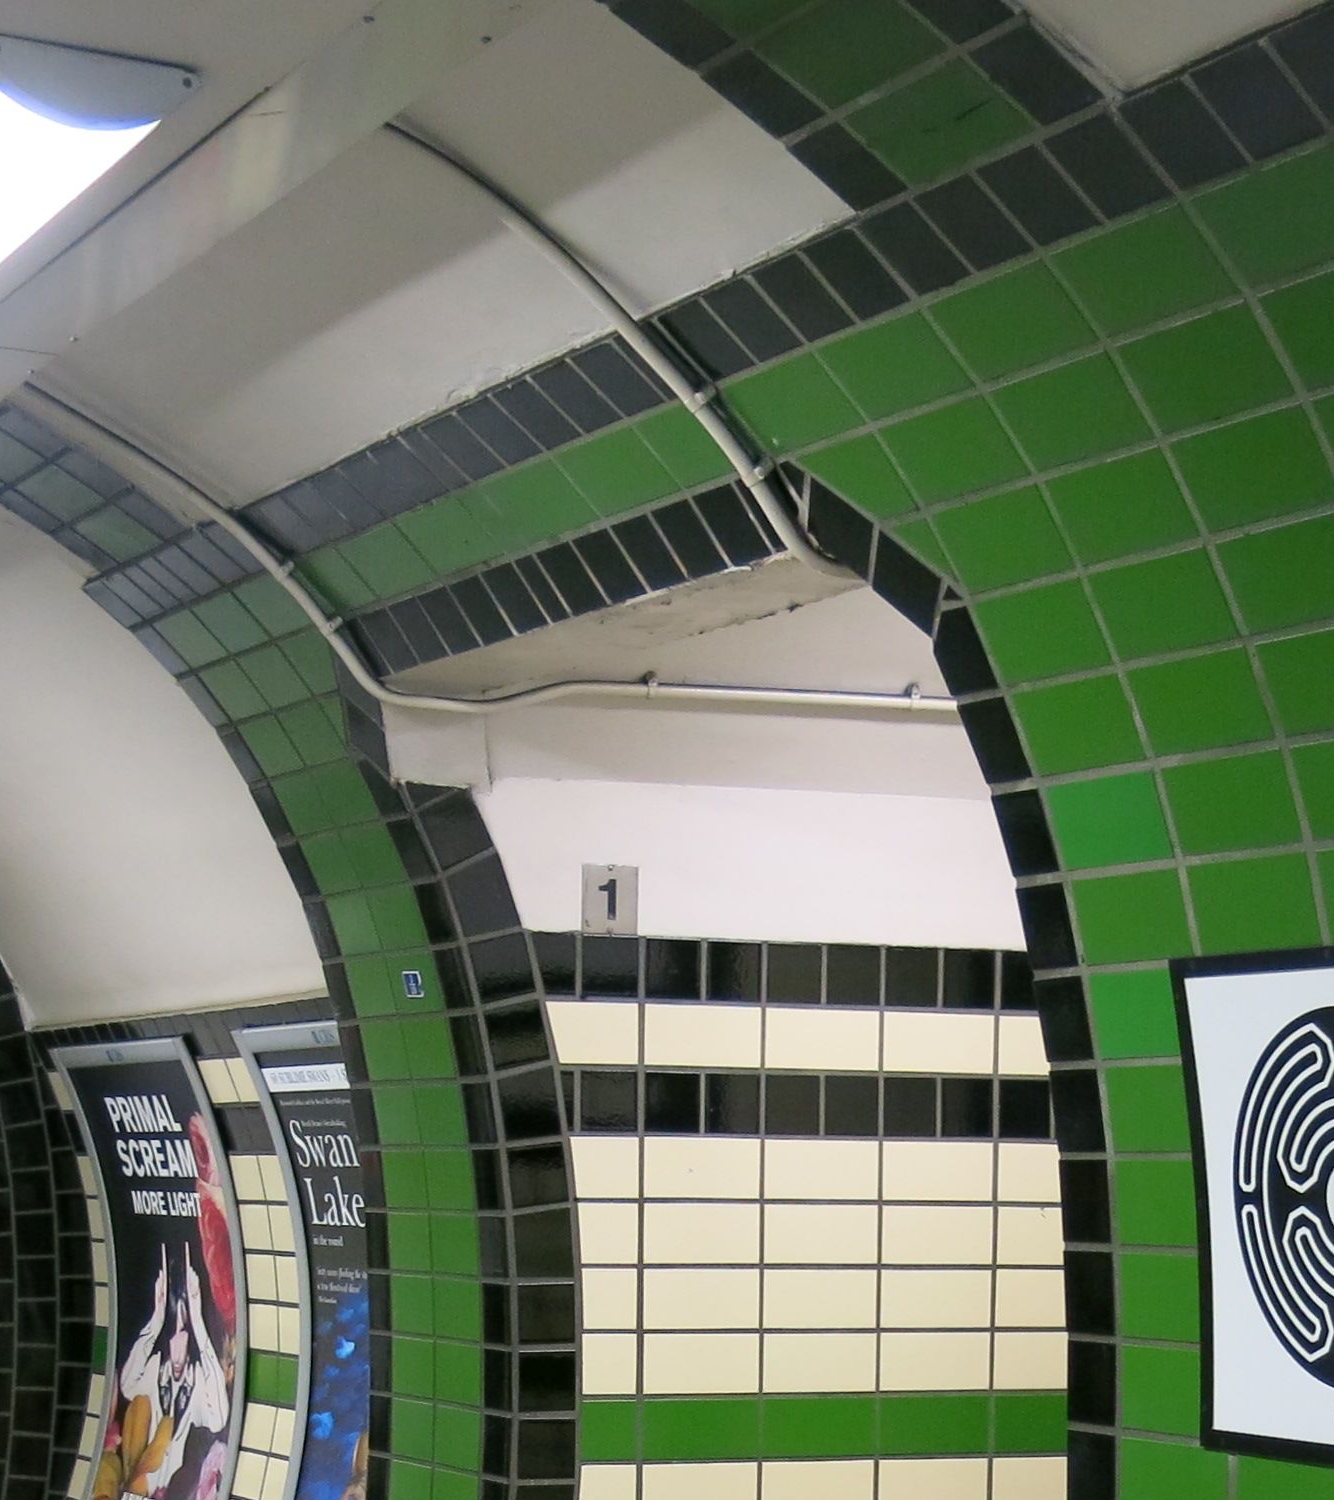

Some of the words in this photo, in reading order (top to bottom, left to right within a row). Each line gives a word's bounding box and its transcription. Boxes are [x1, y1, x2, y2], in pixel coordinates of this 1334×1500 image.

[598, 878, 617, 920] 1
[104, 1094, 182, 1132] PRIMAL
[117, 1139, 199, 1178] SCREAM
[289, 1120, 360, 1168] Swan
[131, 1190, 167, 1215] MORE
[168, 1191, 202, 1217] LIGHT
[304, 1176, 366, 1228] Lake
